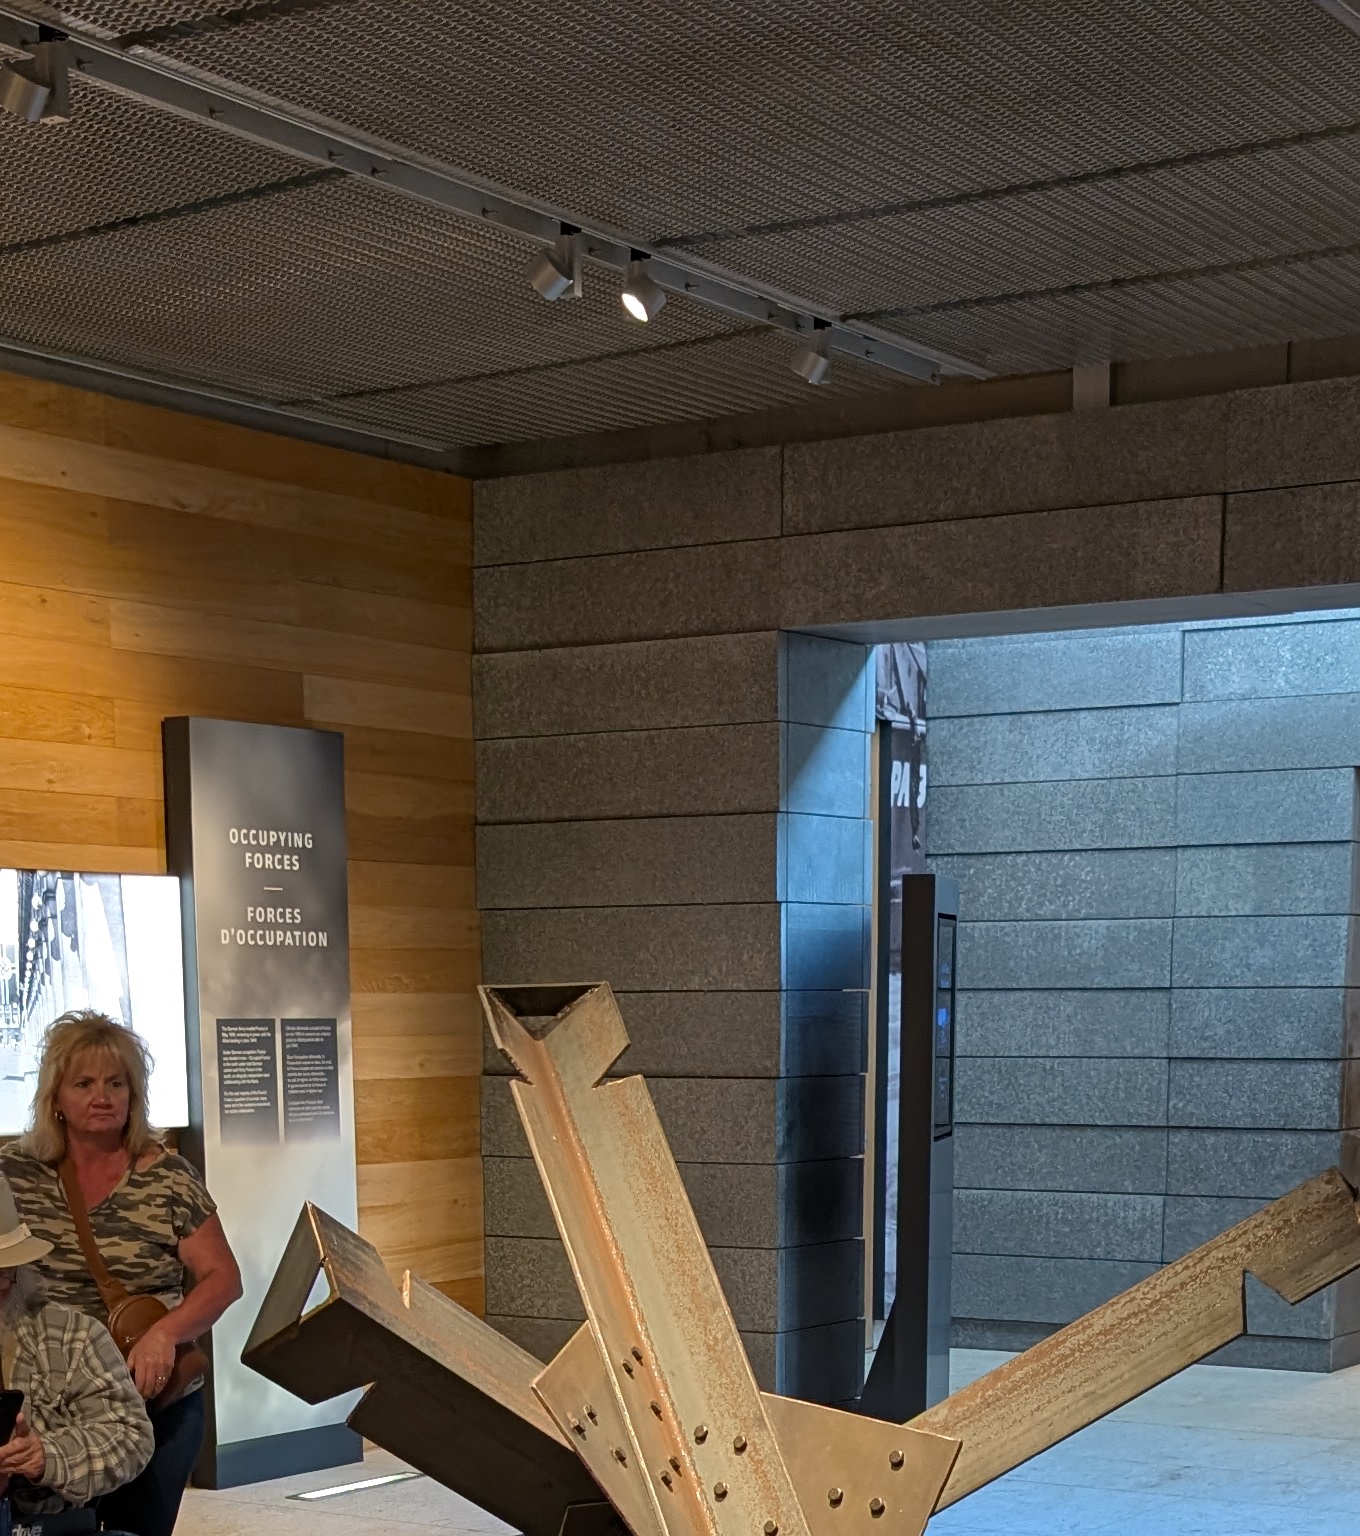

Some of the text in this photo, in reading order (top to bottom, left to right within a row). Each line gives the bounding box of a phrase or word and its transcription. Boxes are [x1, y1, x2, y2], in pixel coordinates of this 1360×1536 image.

[230, 828, 313, 848] OCCUPYING
[245, 853, 299, 871] FORCES
[247, 907, 301, 923] FORCES
[221, 928, 327, 947] D’OCCUPATION
